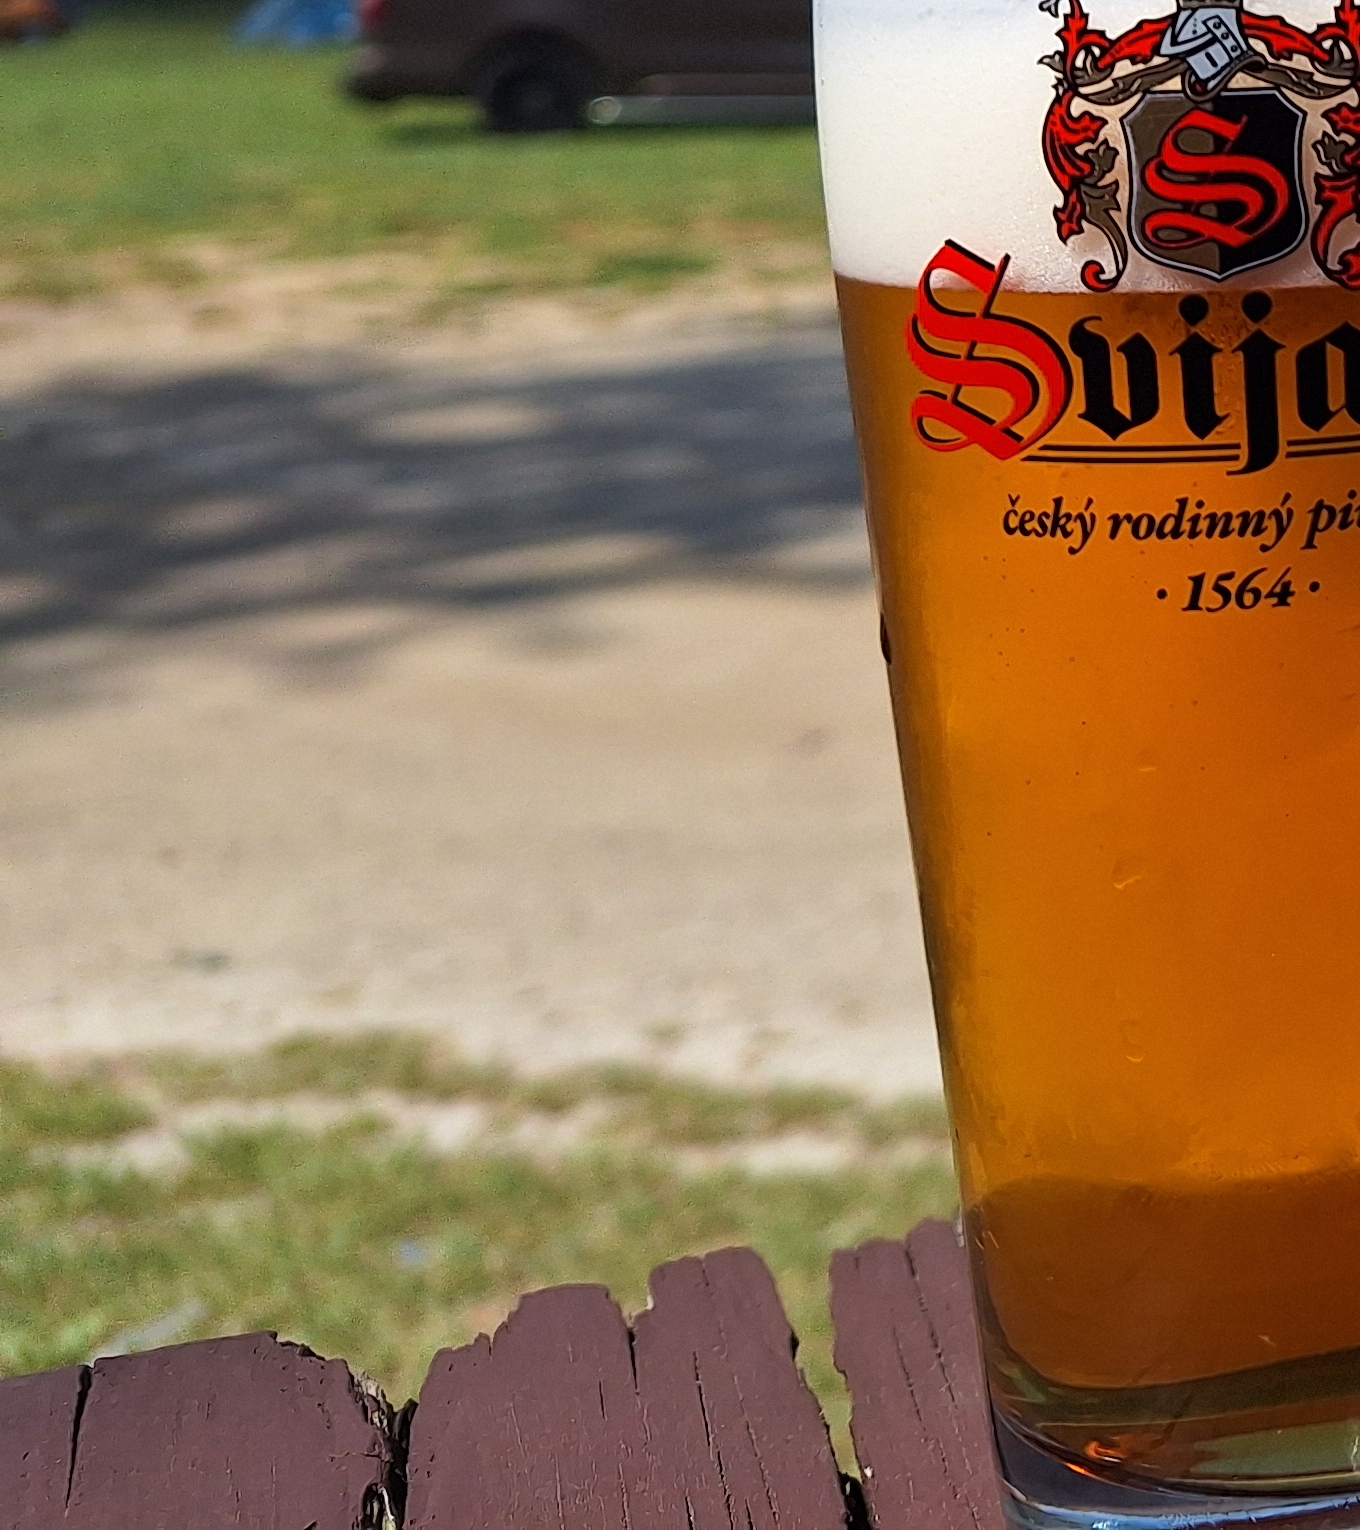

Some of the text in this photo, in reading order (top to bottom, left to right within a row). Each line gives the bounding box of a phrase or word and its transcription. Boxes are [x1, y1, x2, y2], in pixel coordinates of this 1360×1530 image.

[1143, 109, 1289, 250] S
[1002, 495, 1097, 555] český
[1107, 491, 1296, 553] rodinný
